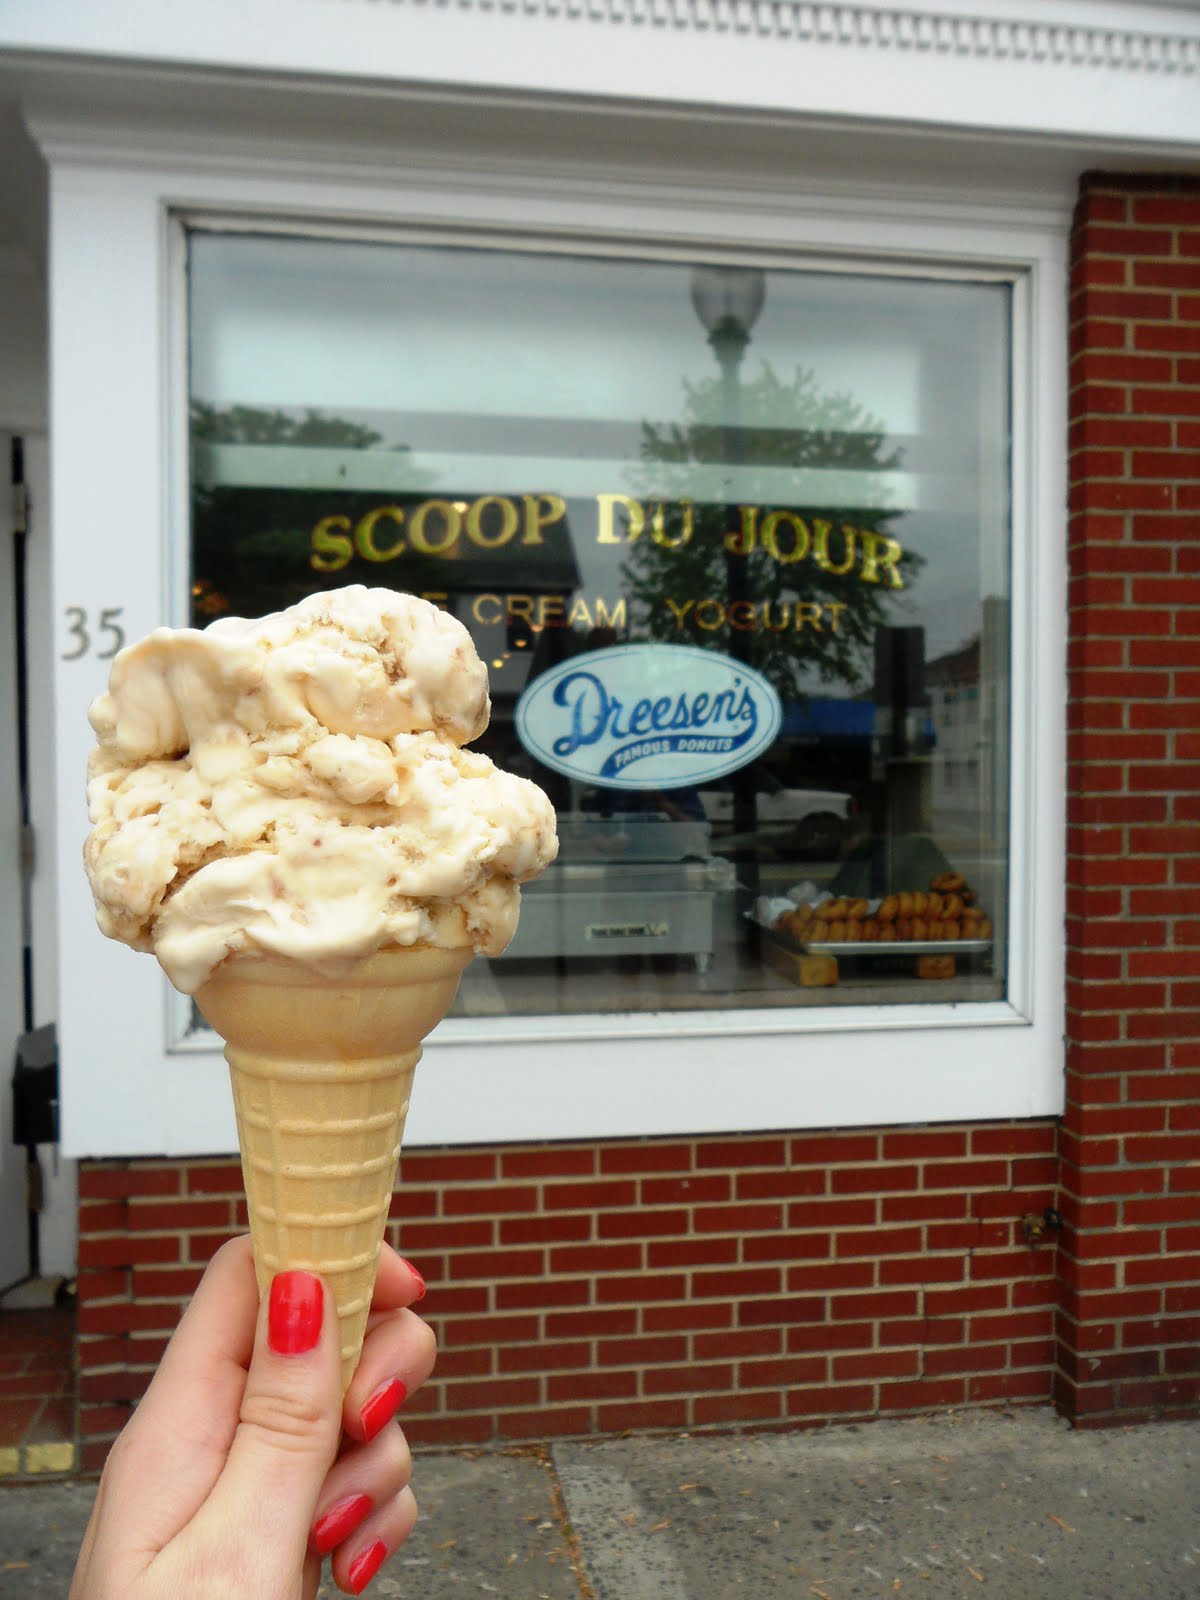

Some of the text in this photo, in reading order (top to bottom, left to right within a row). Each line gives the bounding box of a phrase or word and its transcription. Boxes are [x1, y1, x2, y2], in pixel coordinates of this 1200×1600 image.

[309, 493, 904, 589] SCOOP DU JOUR
[61, 606, 125, 661] 35
[472, 592, 628, 629] CREAM
[665, 598, 849, 632] YOGURT
[553, 671, 758, 757] Dreesen's
[614, 738, 734, 769] FAMOUS DONUTS
